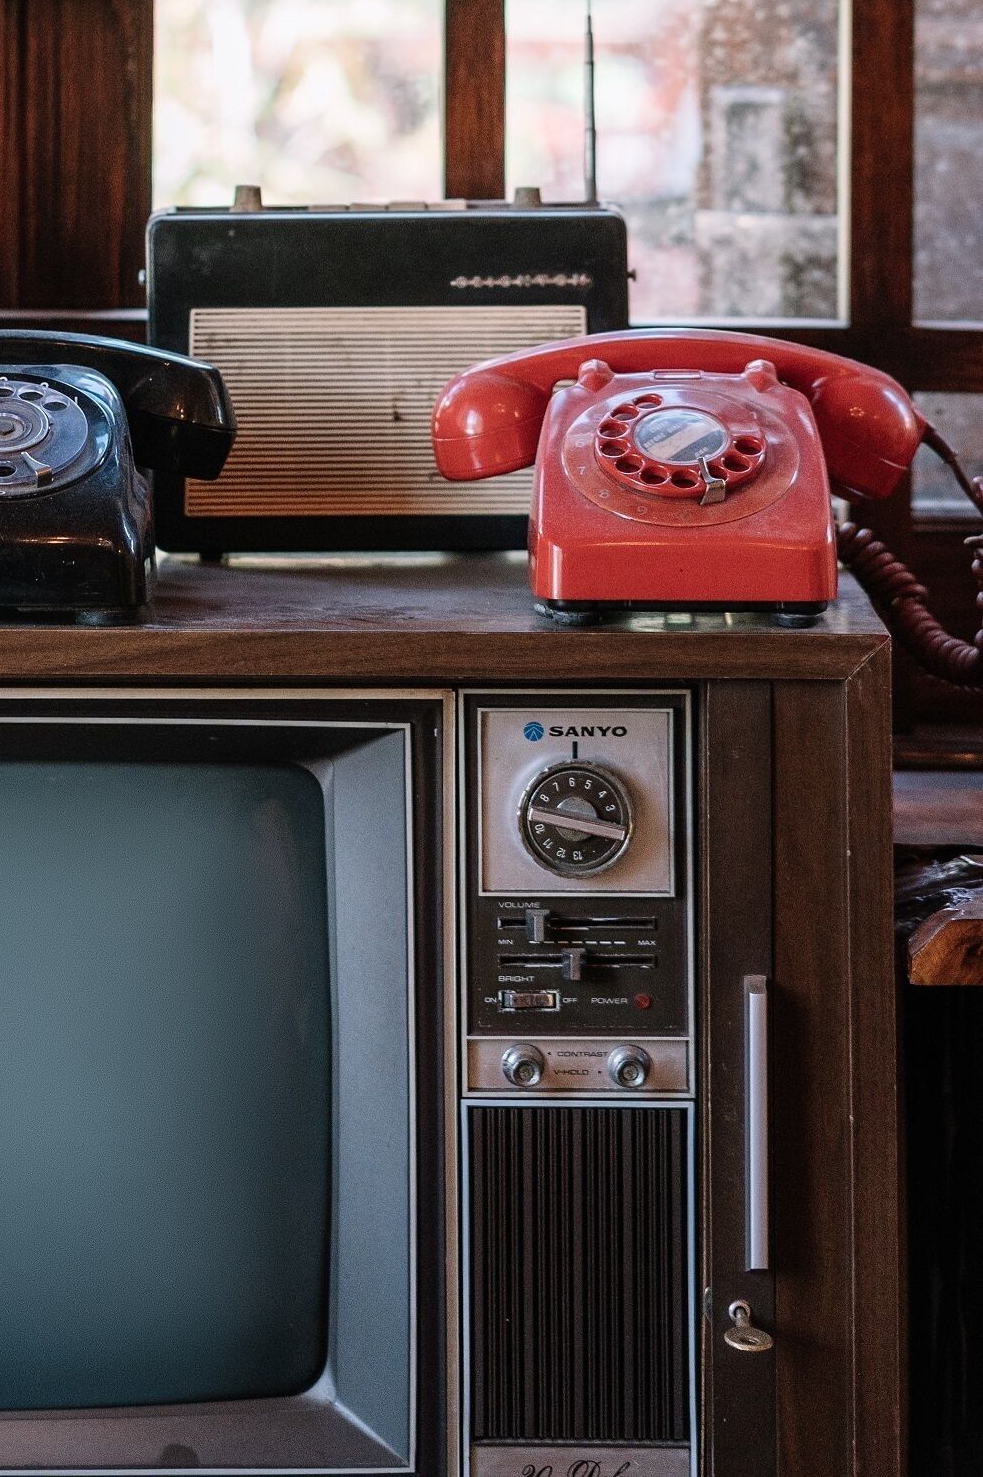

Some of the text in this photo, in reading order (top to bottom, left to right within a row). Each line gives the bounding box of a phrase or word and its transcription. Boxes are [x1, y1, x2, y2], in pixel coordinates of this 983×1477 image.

[576, 466, 586, 476] 7
[548, 725, 628, 738] SANYO
[552, 782, 560, 792] 7
[568, 777, 576, 788] 6
[584, 779, 593, 790] 5
[539, 793, 549, 803] 8
[598, 789, 607, 799] 4
[605, 804, 616, 813] 3
[534, 823, 546, 835] 10
[542, 838, 554, 849] 11
[556, 847, 567, 859] 12
[572, 850, 583, 861] 13
[498, 901, 541, 909] VOLUME
[498, 975, 535, 983] BRIGHT
[590, 997, 629, 1005] POWER
[553, 1068, 590, 1076] V-HOLD
